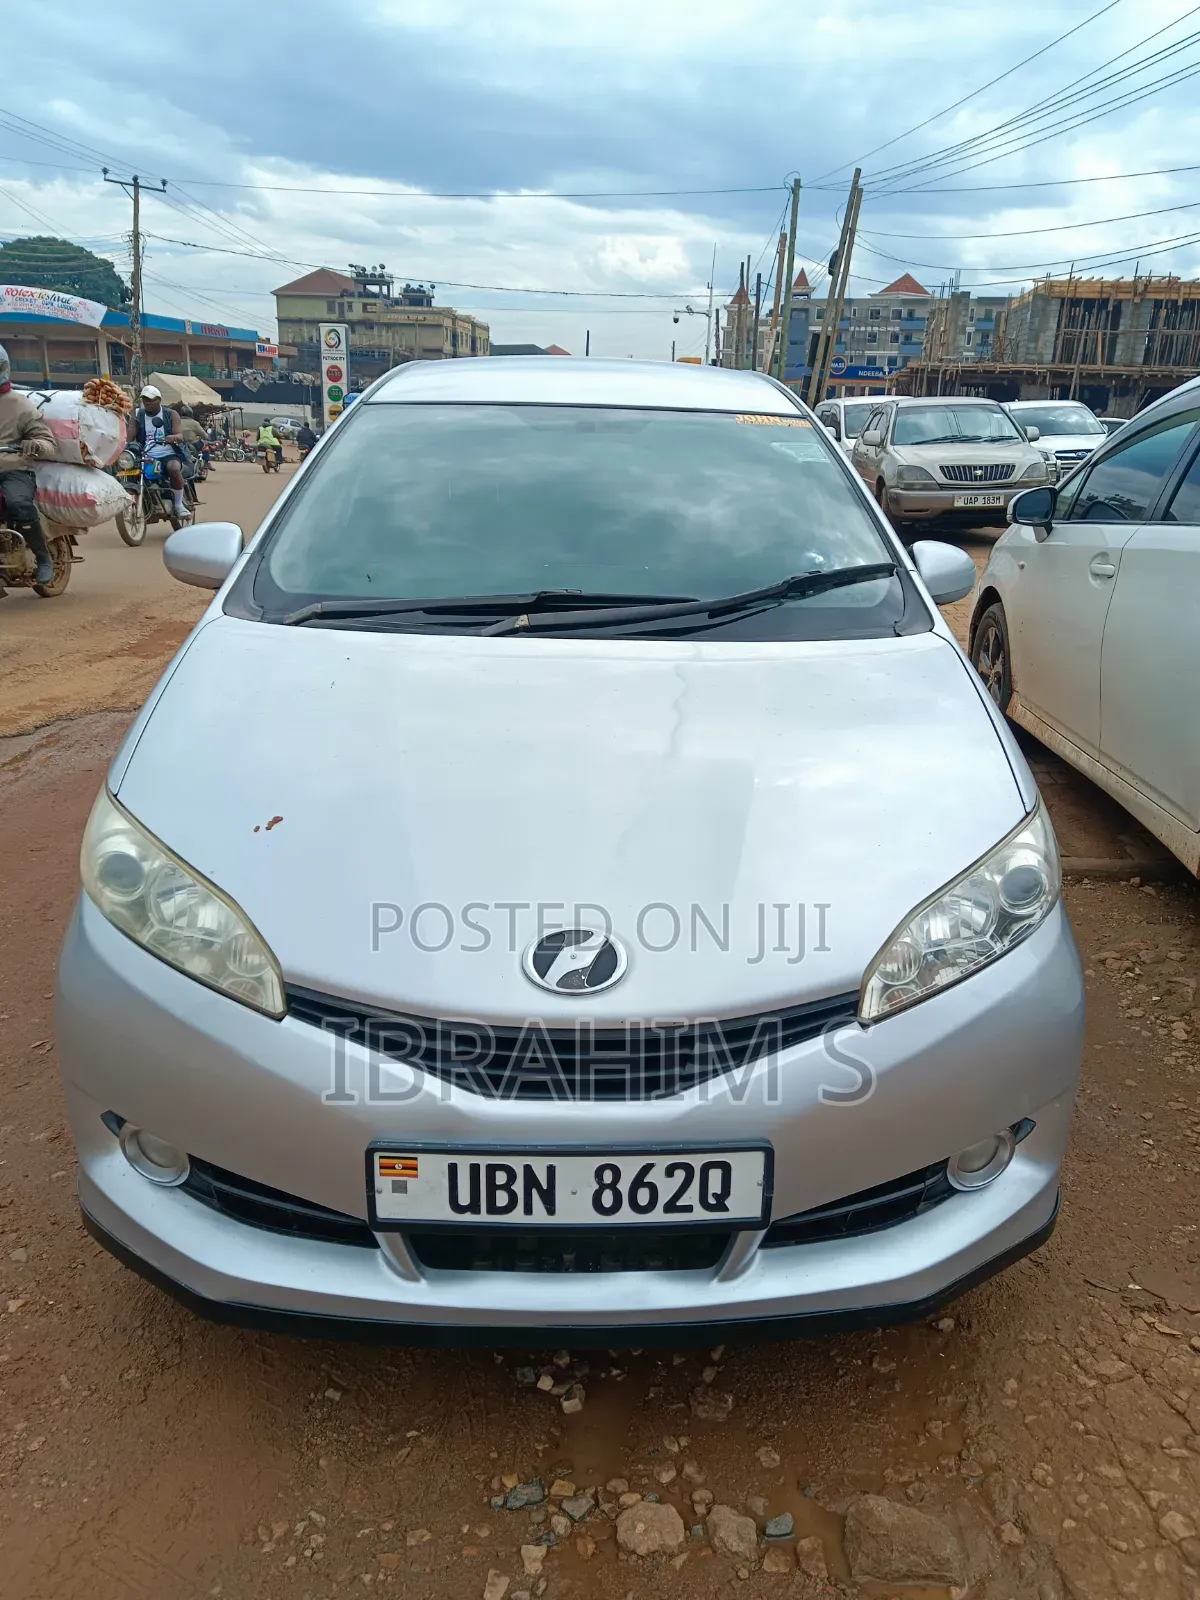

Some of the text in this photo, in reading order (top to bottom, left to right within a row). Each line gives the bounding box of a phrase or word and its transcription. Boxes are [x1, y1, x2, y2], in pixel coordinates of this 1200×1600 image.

[5, 287, 36, 298] Rolex
[963, 496, 978, 505] UAP
[447, 1160, 732, 1216] UBN 862Q
